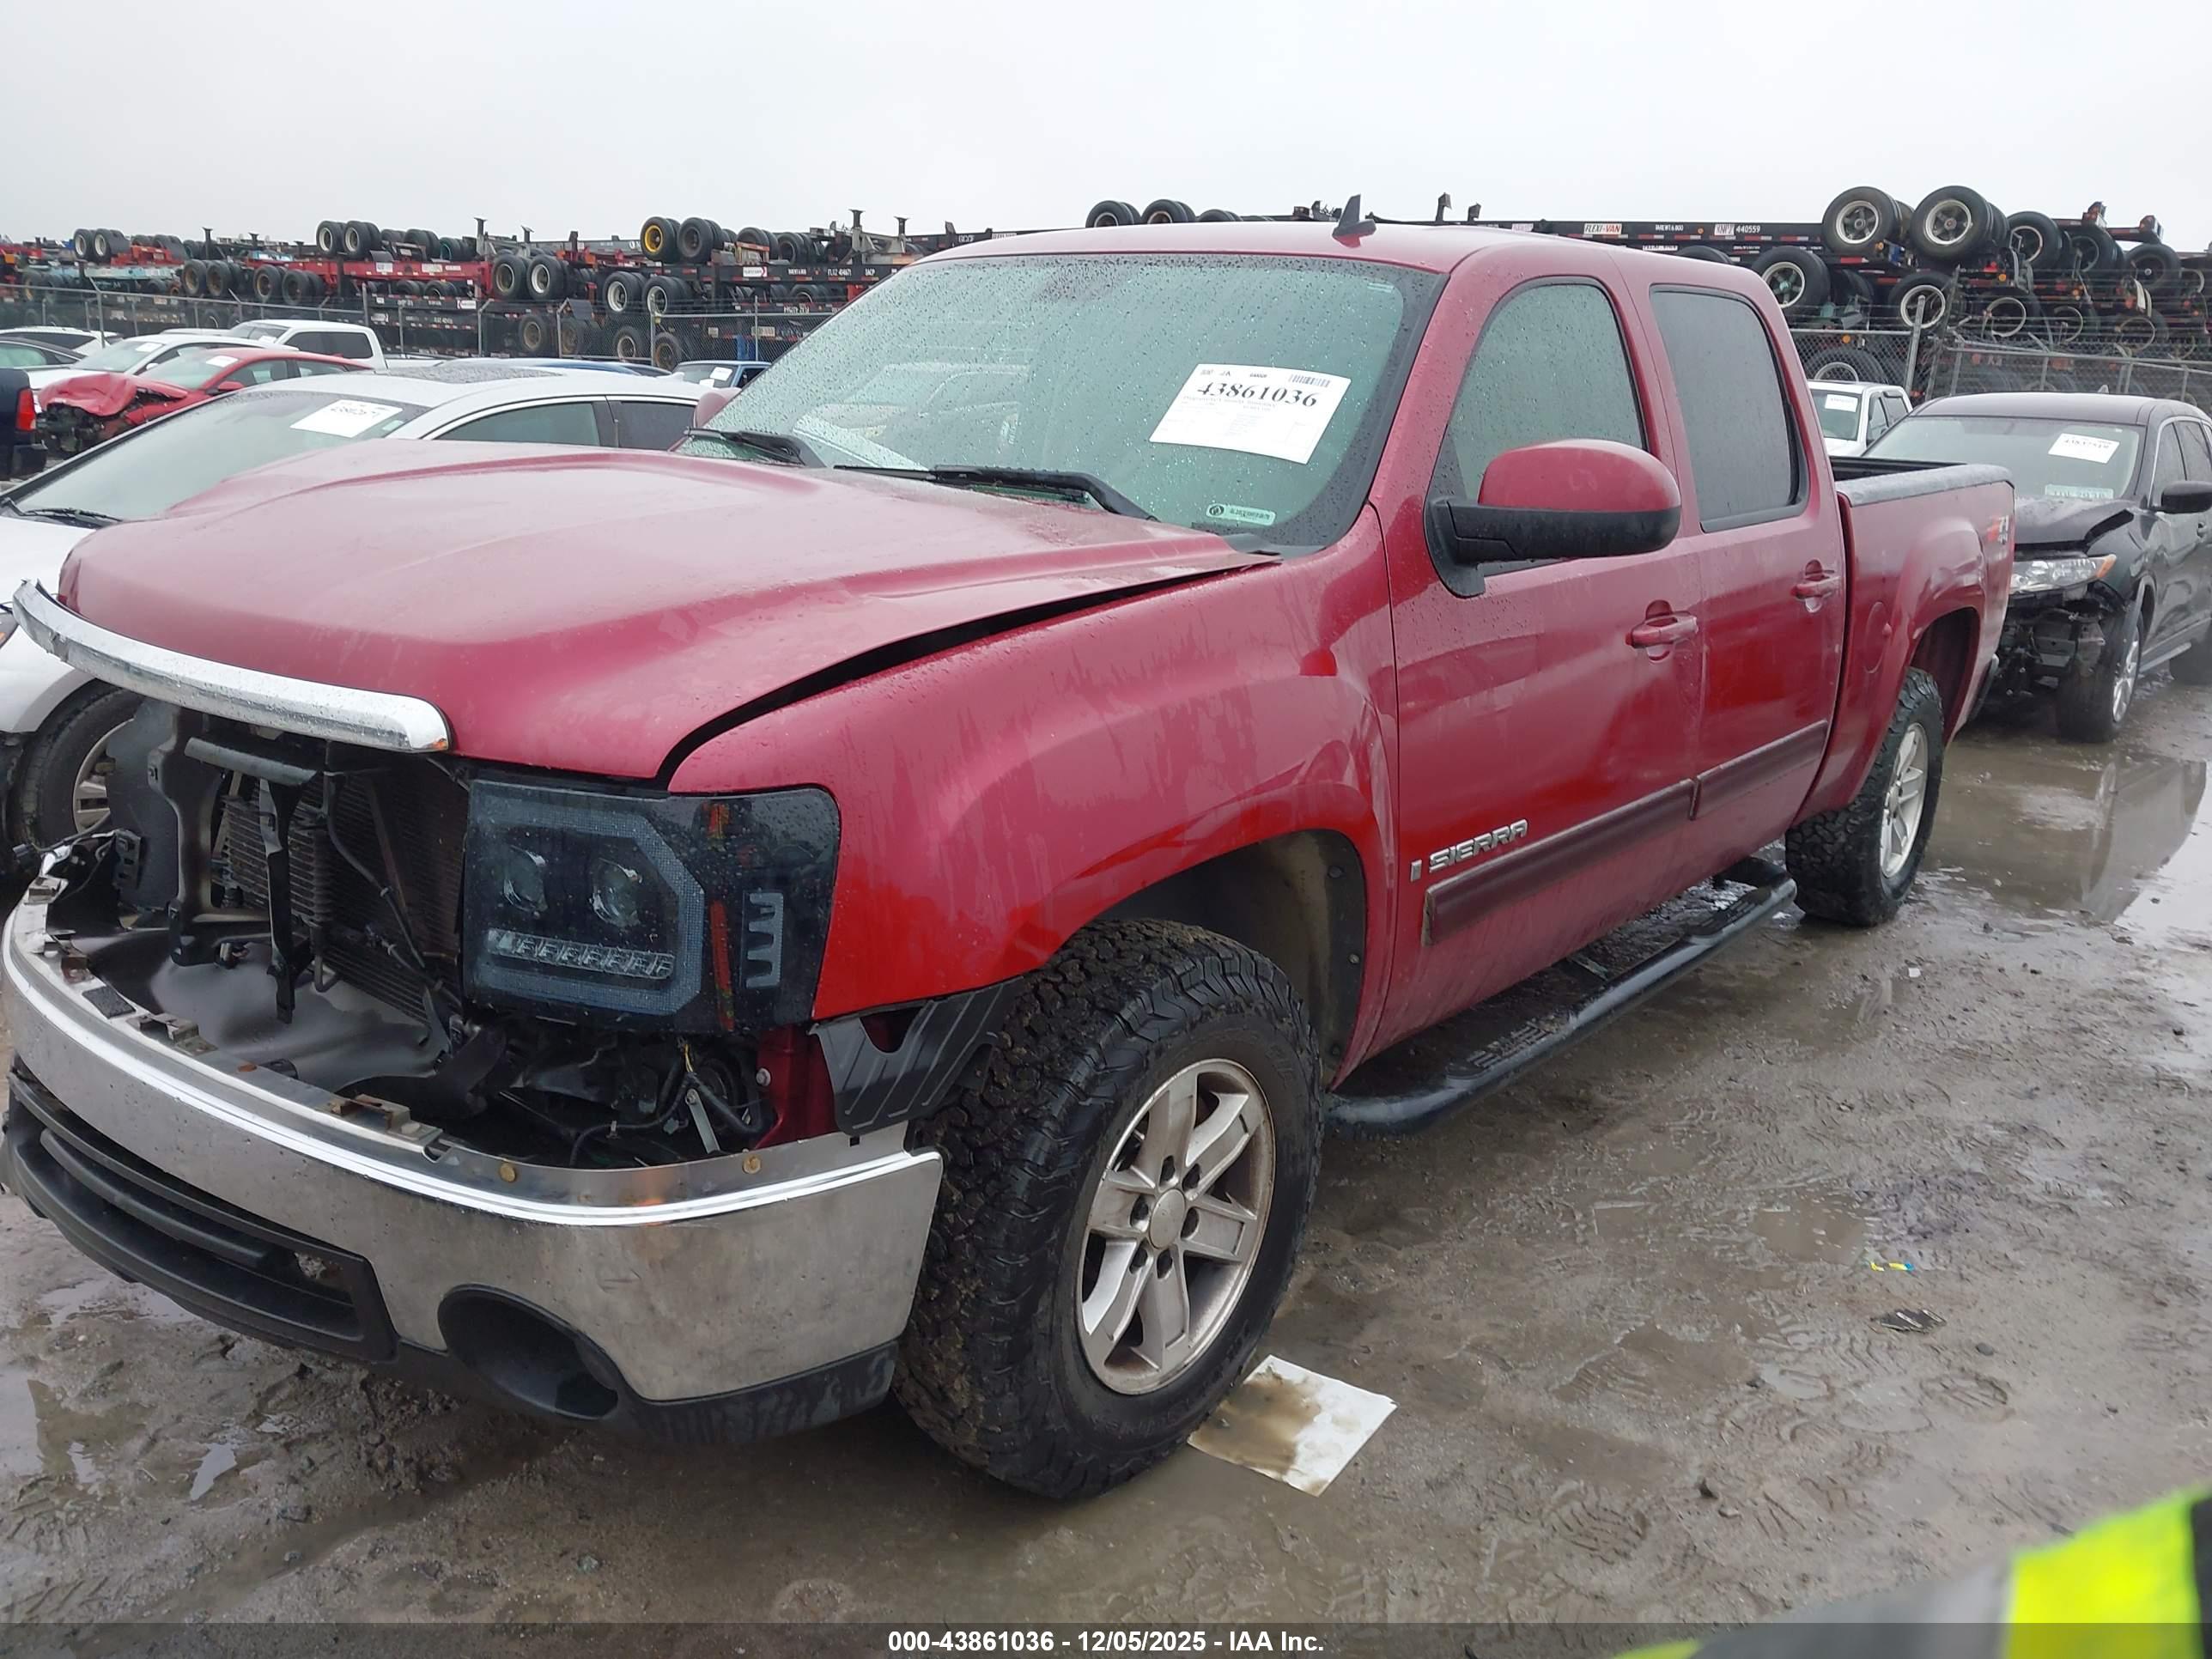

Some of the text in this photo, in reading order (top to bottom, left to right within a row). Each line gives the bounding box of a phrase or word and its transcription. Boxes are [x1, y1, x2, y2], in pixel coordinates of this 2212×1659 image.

[1584, 223, 1621, 234] FLEXI-VAN
[1735, 225, 1761, 234] 440559
[1197, 382, 1320, 407] 43861036
[1429, 818, 1528, 872] SIERRA
